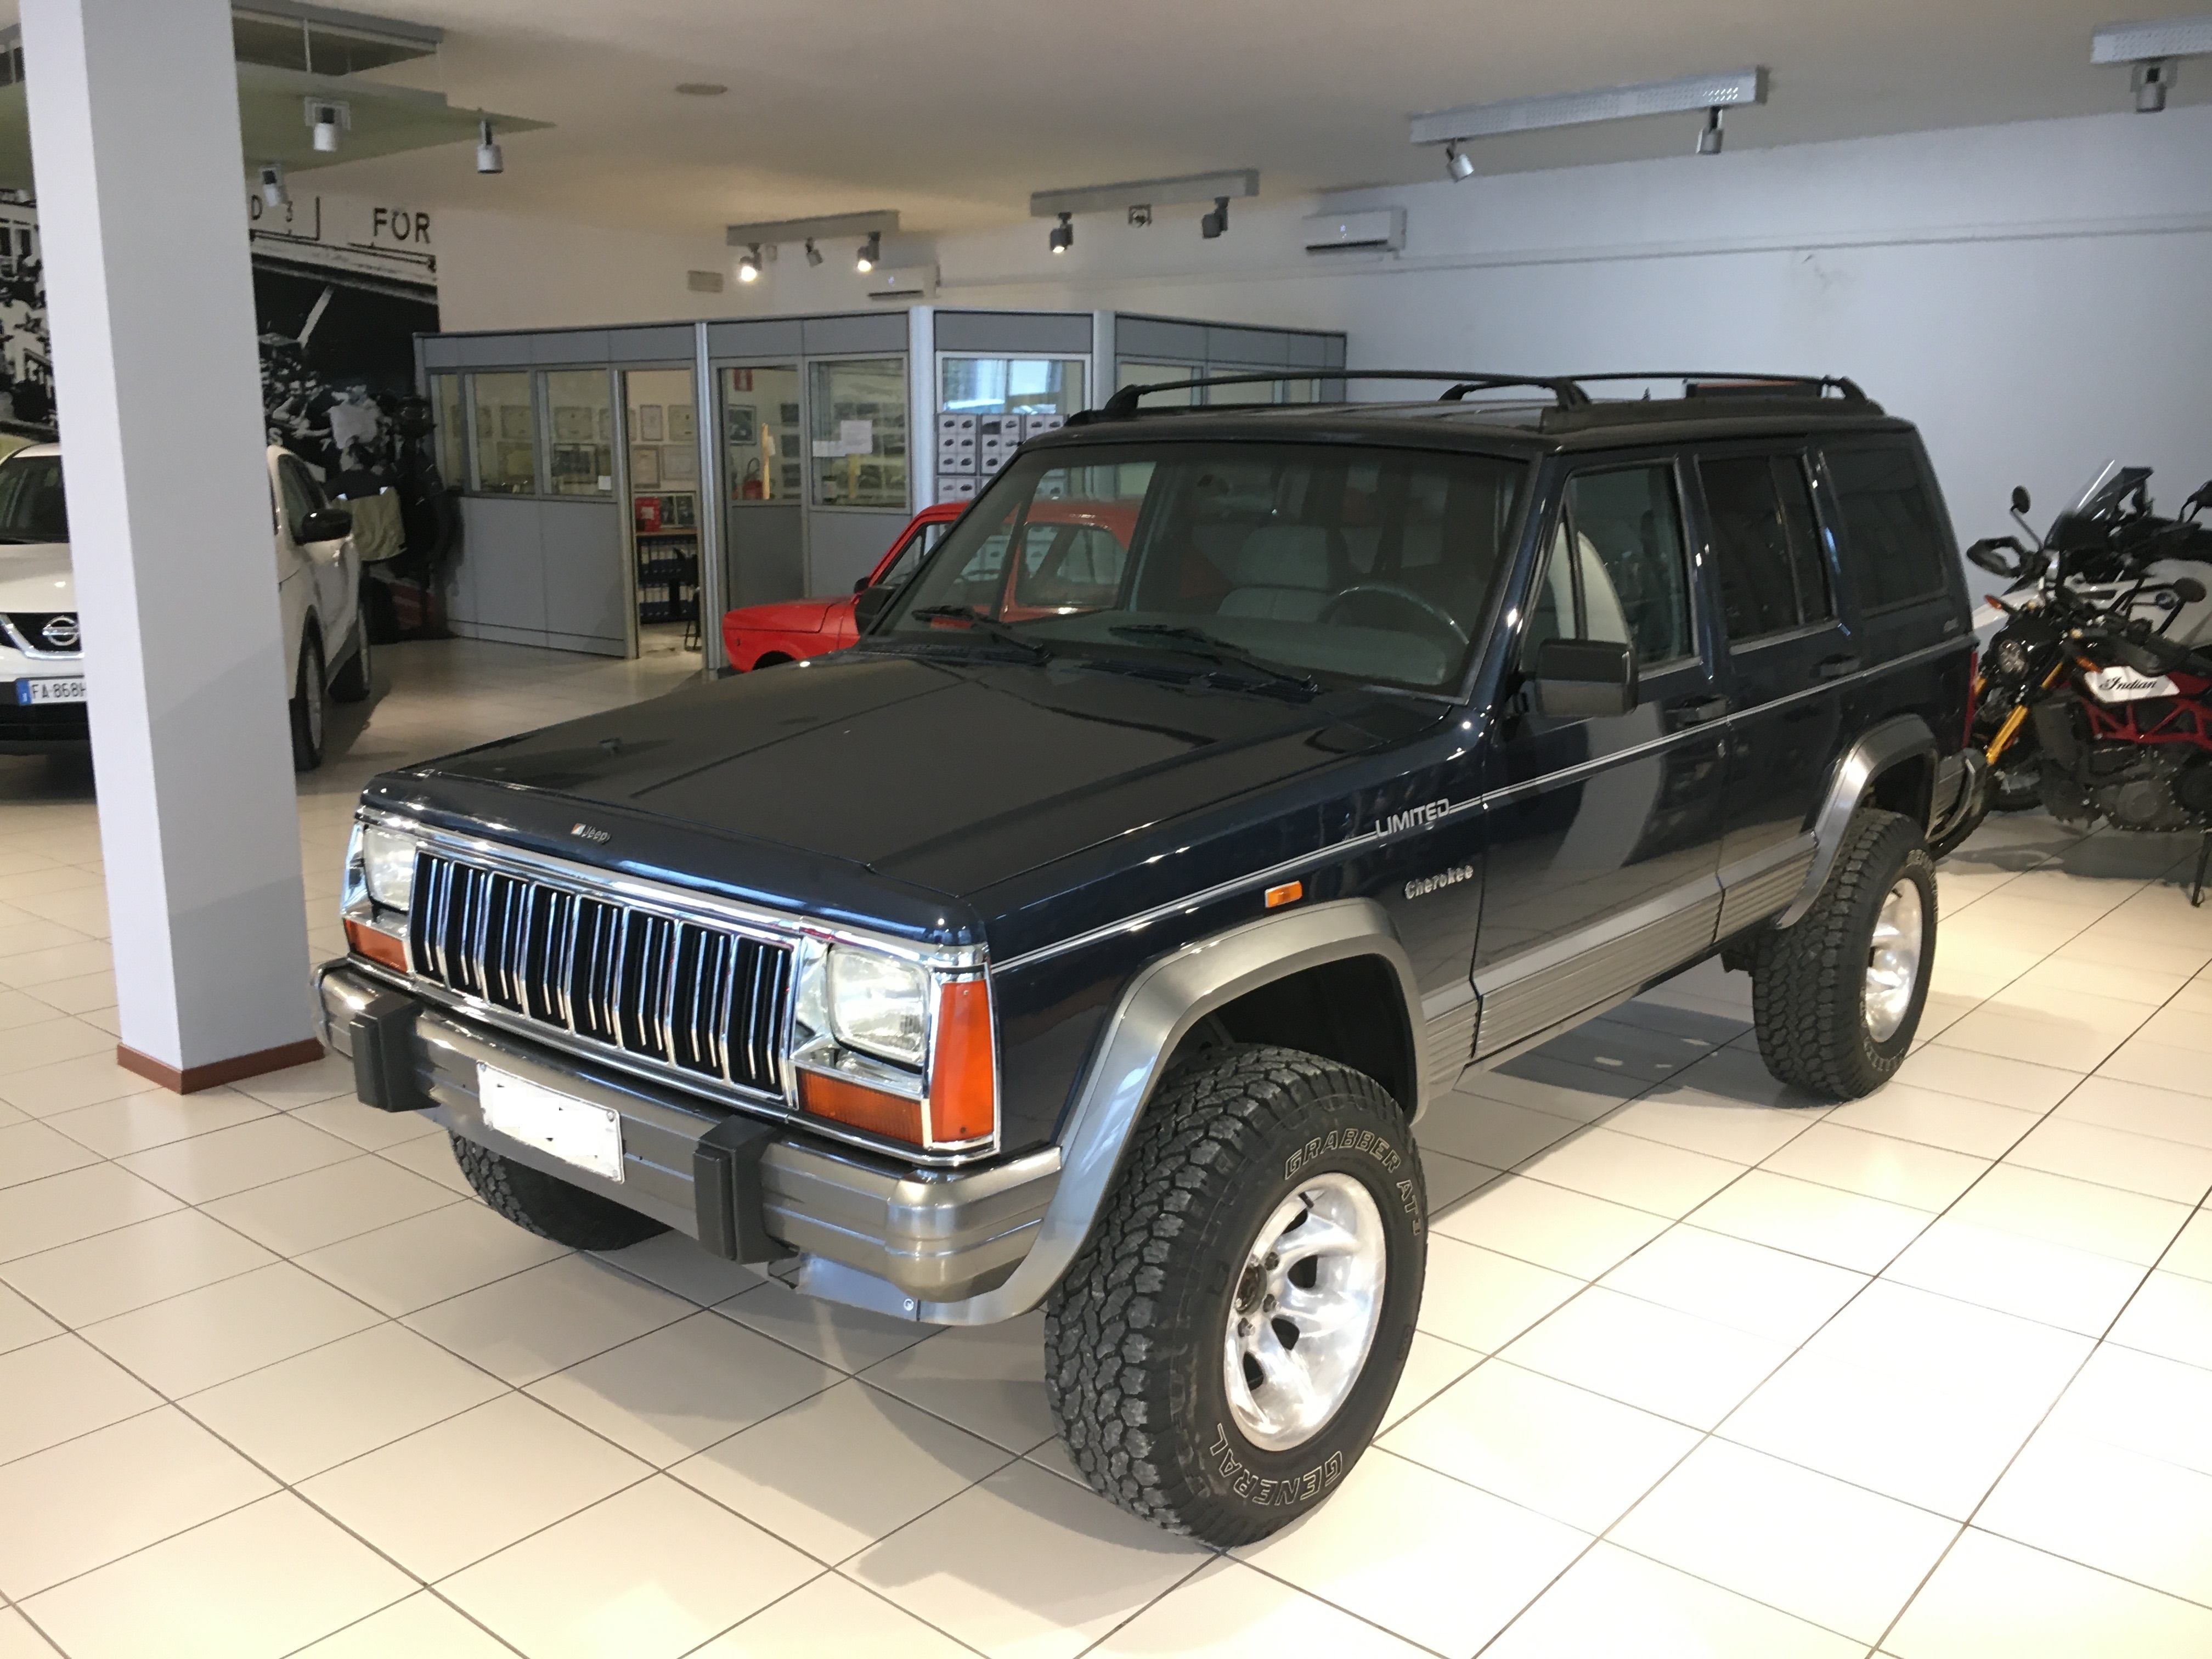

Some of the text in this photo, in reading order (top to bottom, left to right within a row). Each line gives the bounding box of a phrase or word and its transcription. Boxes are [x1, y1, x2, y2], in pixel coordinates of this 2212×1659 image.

[373, 207, 431, 244] FOR
[2098, 676, 2158, 691] Indian
[582, 825, 611, 843] Jeep
[1374, 798, 1449, 838] LIMITED
[1404, 865, 1474, 900] Cherokee
[1284, 1128, 1402, 1181] GRABBER
[1209, 1423, 1344, 1506] GENERAL
